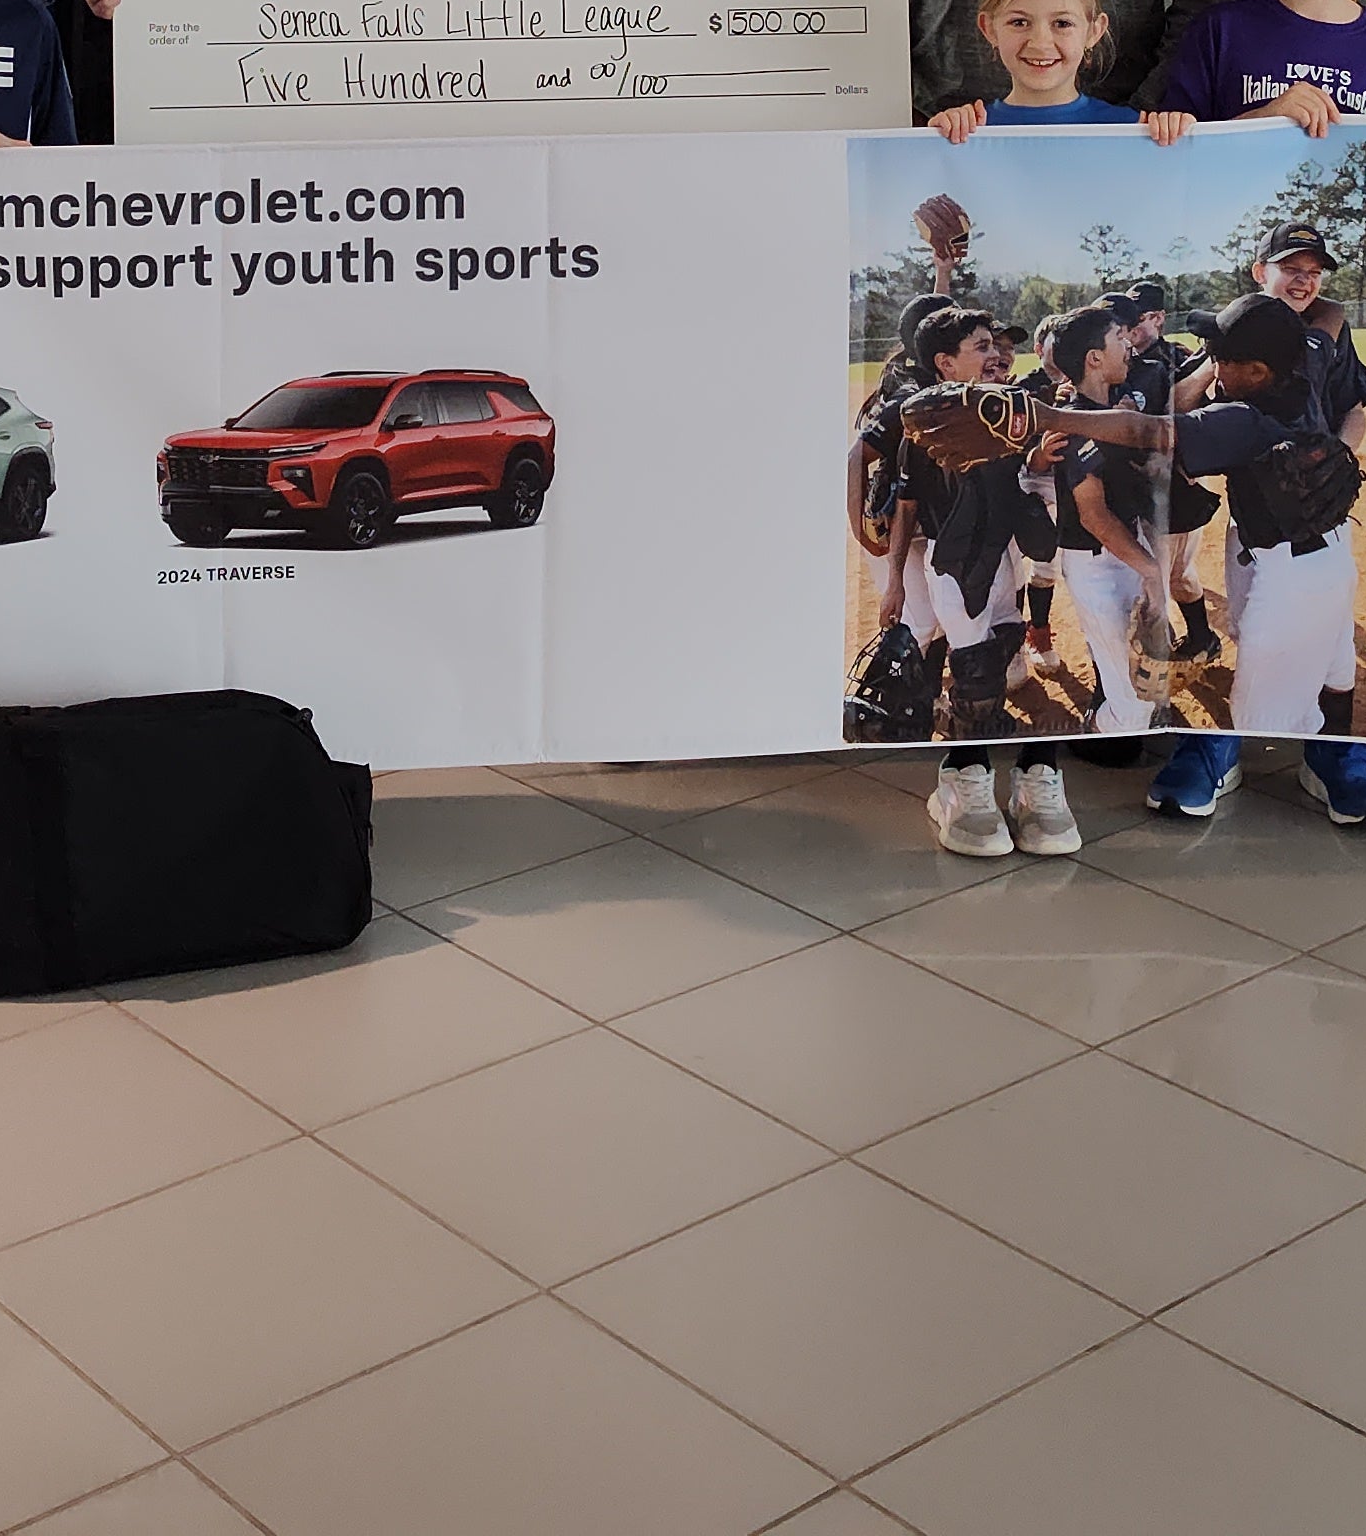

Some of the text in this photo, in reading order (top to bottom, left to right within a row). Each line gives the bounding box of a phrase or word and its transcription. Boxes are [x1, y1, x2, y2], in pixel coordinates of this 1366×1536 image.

[149, 22, 200, 34] Pay to the
[259, 2, 350, 40] Seneca
[361, 1, 425, 38] Falls
[446, 0, 546, 39] Little
[709, 13, 722, 34] $
[149, 35, 189, 45] order of
[238, 47, 311, 103] Five
[344, 53, 487, 101] Hundred
[536, 68, 572, 89] and
[835, 84, 869, 95] Dollars
[230, 237, 395, 296] youth
[415, 237, 600, 291] sports
[157, 566, 295, 585] 2024 TRAVERSE
